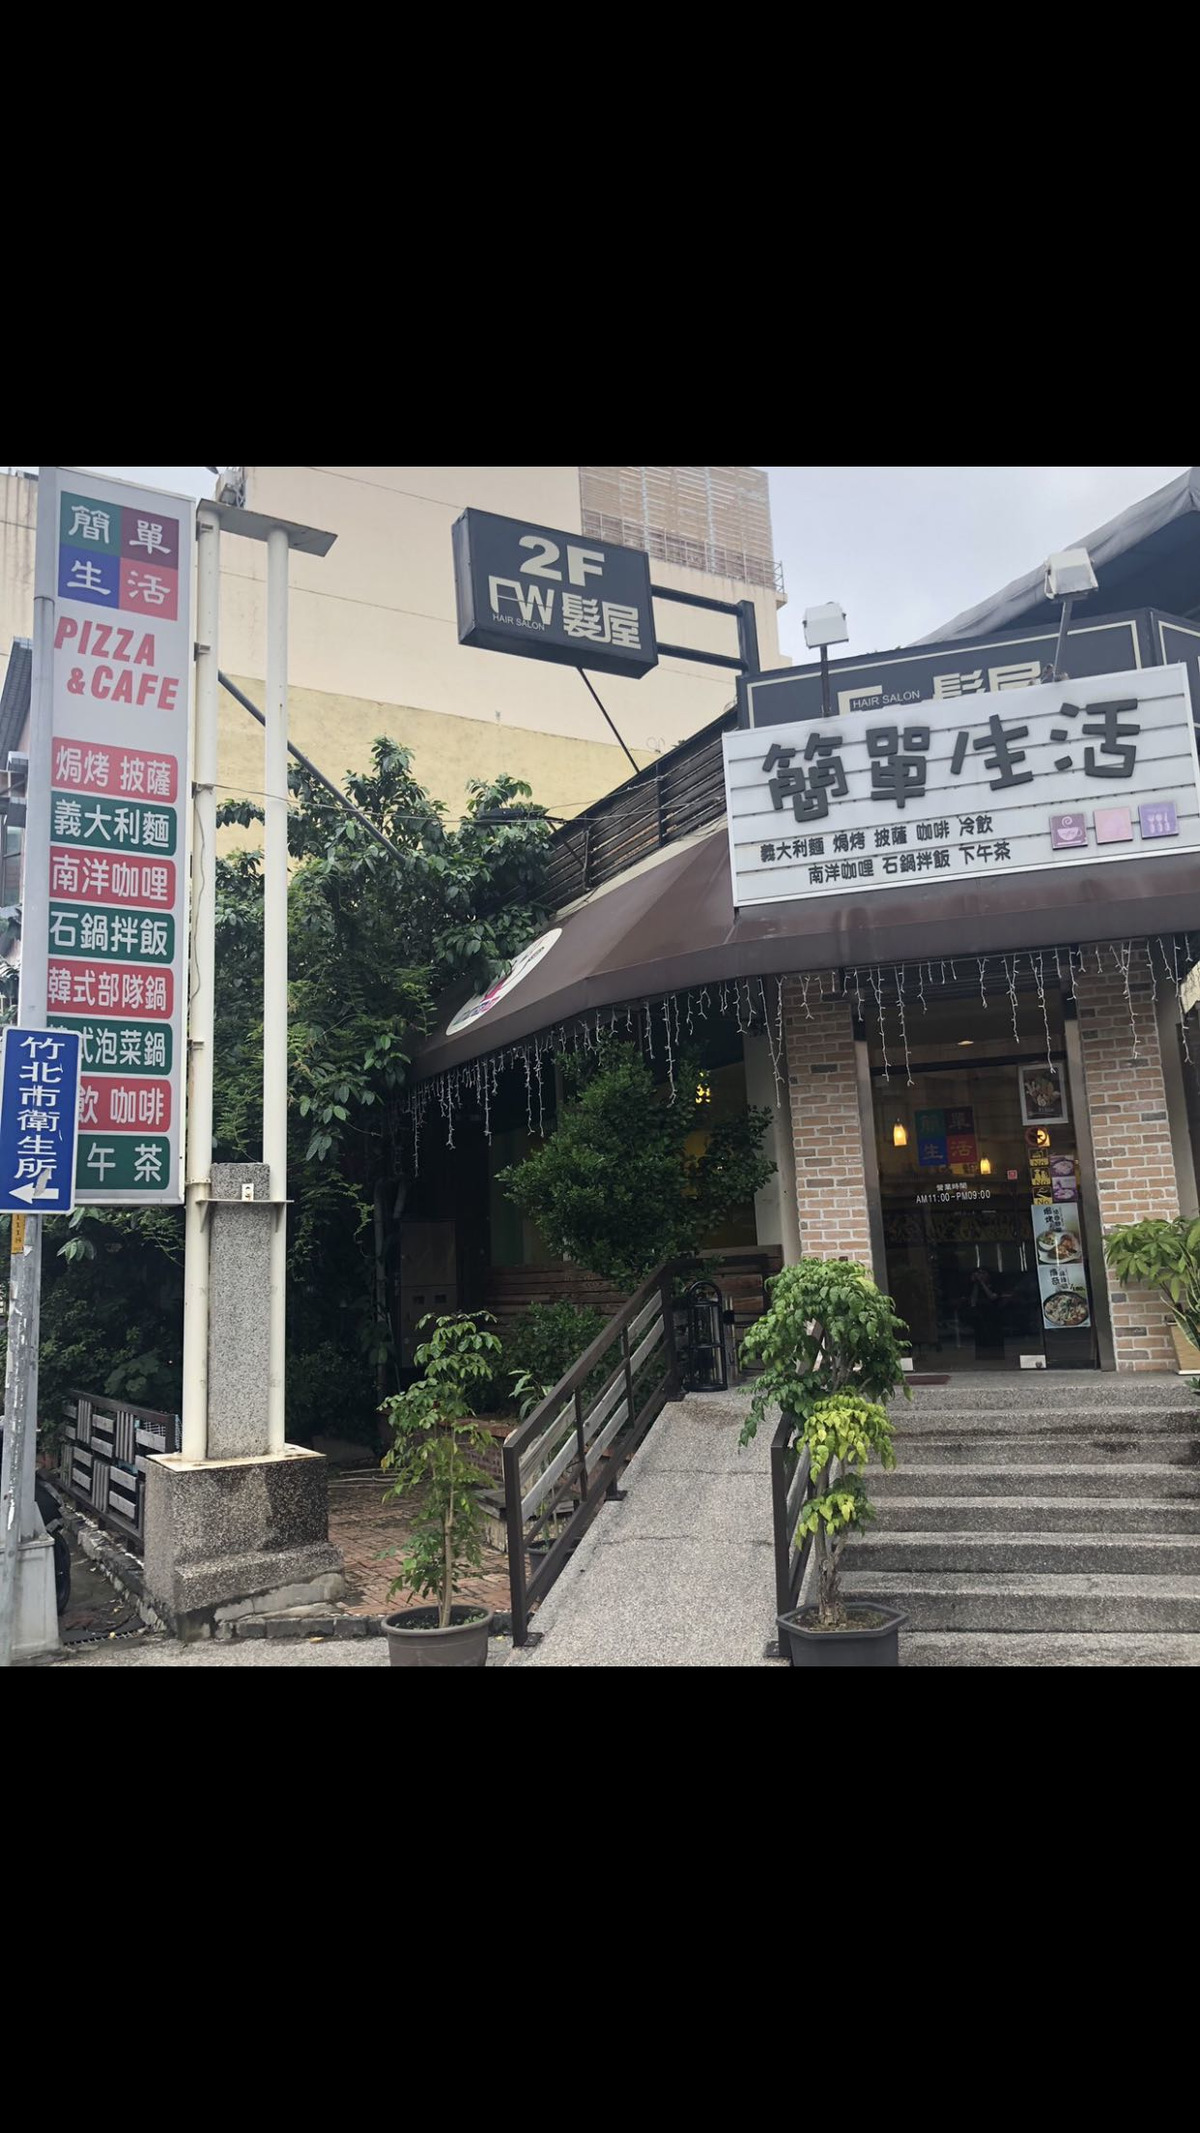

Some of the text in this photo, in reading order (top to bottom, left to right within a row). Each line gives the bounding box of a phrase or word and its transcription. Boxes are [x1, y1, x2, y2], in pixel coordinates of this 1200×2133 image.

[68, 504, 172, 555] 簡單
[66, 560, 172, 605] 生活
[518, 535, 606, 587] 2F
[54, 616, 156, 667] PIZZA
[492, 613, 546, 632] HAIR SALON
[852, 695, 881, 710] HAIR
[882, 689, 921, 705] SALON
[55, 745, 172, 798] 焗烤 披薩
[762, 698, 1142, 824] 簡單生活
[54, 798, 171, 849] 義大利麵
[760, 837, 825, 863] 義大利麵
[874, 827, 908, 848] 披薩
[917, 820, 950, 842] 咖啡
[959, 814, 993, 837] 冷飲
[52, 853, 169, 903] 南洋咖哩
[808, 841, 1012, 885] 南洋咖哩 石鍋拌飯 下午茶
[49, 910, 168, 958] 石鍋拌飯
[47, 966, 167, 1012] 韓式部隊鍋
[50, 1024, 166, 1068] 式泡菜鍋
[14, 1036, 65, 1180] 竹北市衛生所
[110, 1086, 165, 1126] 咖啡
